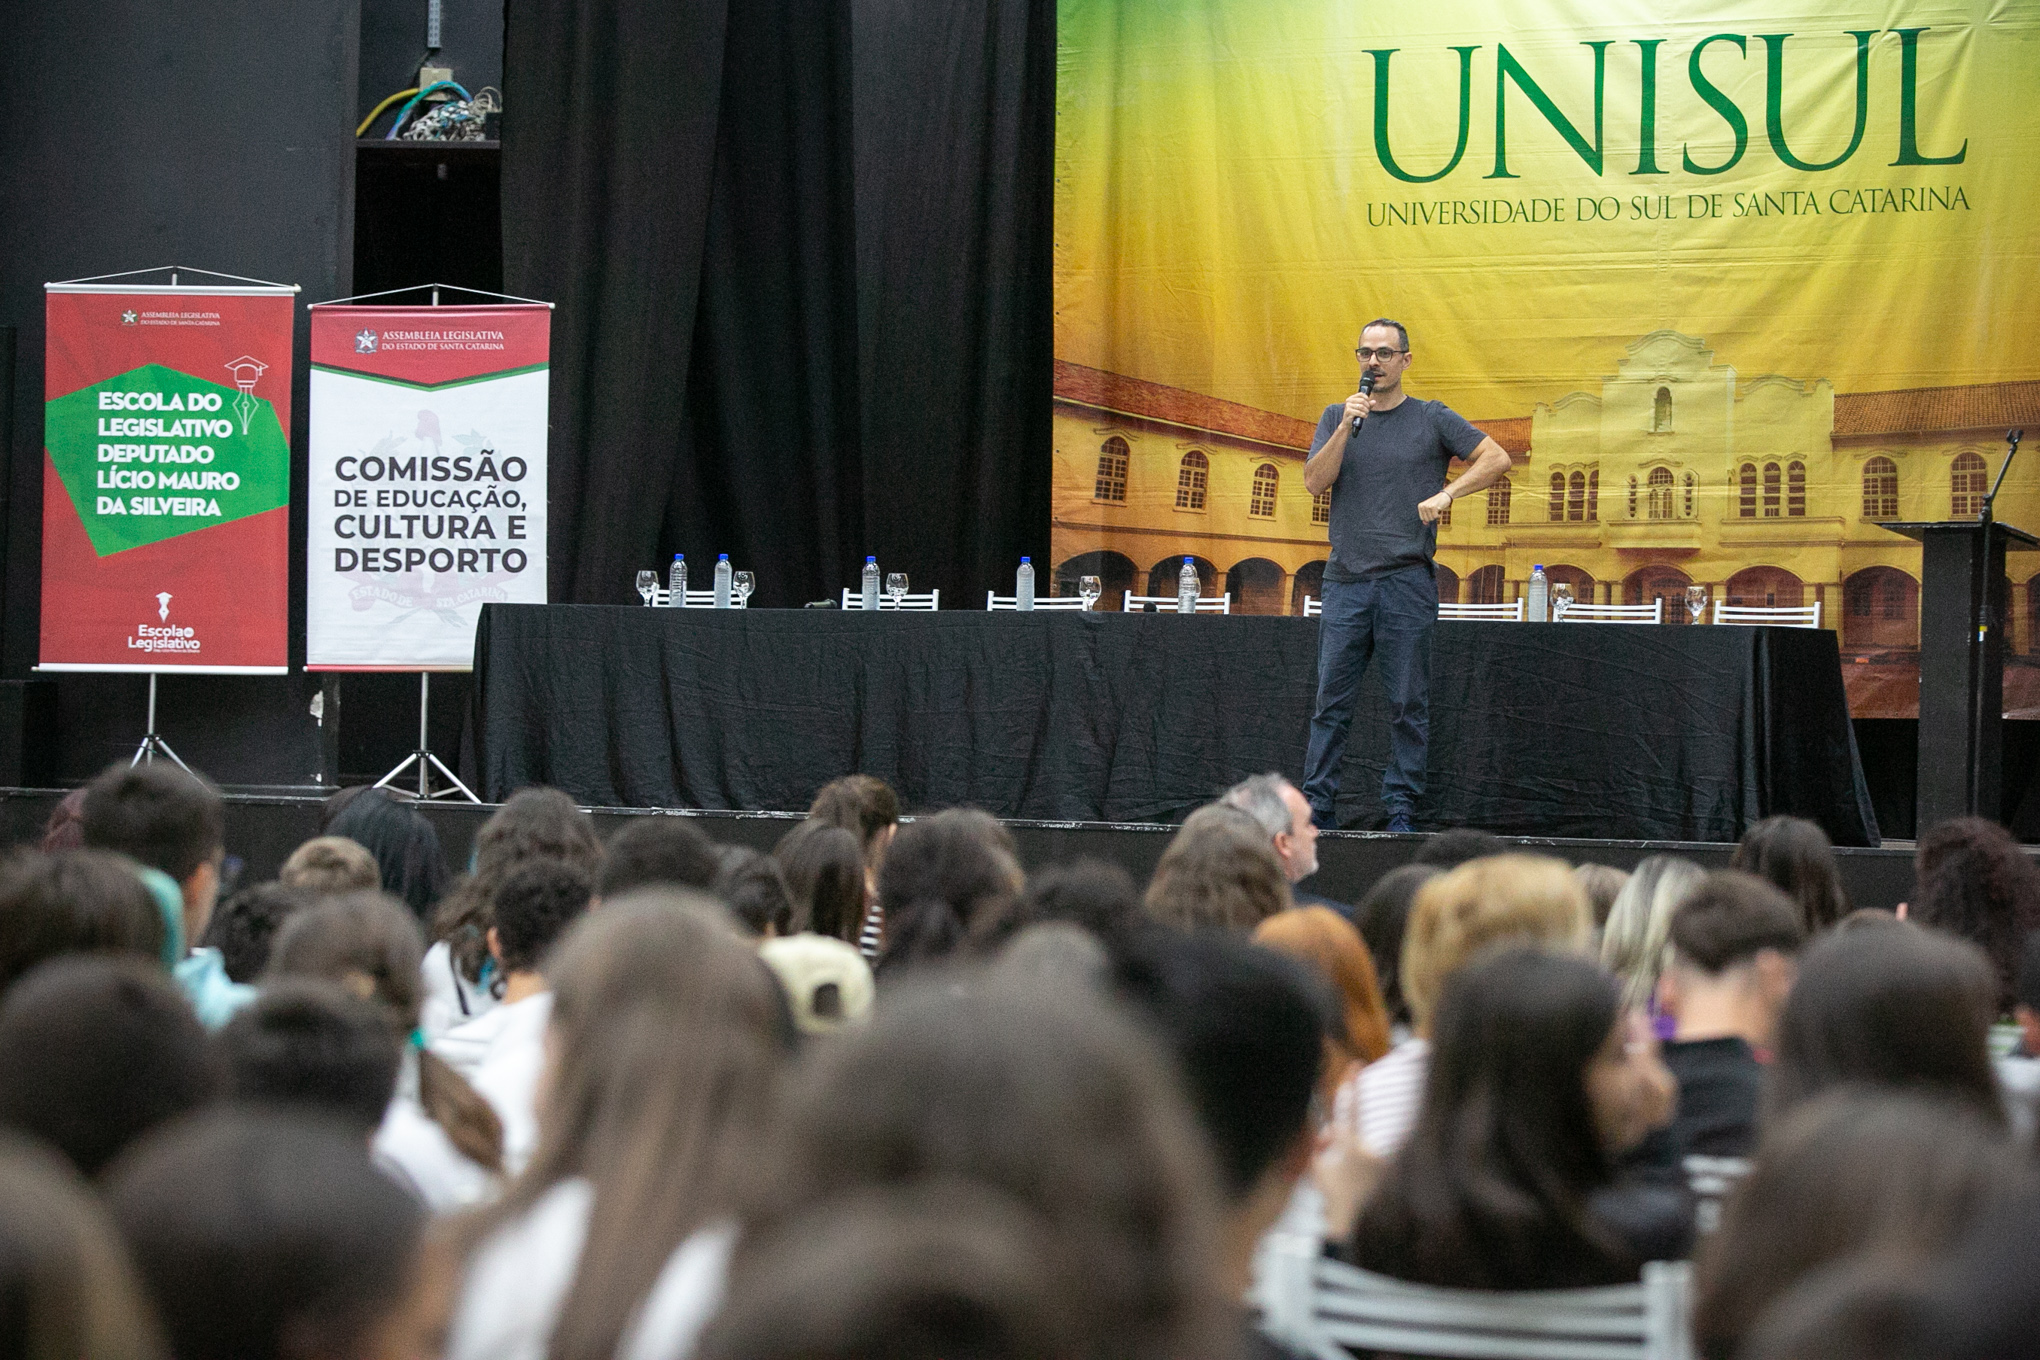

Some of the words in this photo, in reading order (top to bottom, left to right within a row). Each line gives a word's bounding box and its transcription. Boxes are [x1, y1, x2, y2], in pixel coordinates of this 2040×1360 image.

[1361, 27, 1968, 184] UNISUL
[1367, 198, 1565, 227] UNIVERSIDADE
[1576, 196, 1621, 222] DO
[1630, 195, 1678, 220] SUL
[1687, 193, 1723, 219] DE
[1733, 191, 1821, 218] SANTA
[1829, 186, 1972, 214] CATARINA
[382, 331, 441, 340] ASSEMBLEIA
[443, 331, 504, 340] LEGISLATIVA
[98, 391, 185, 411] ESCOLA
[187, 392, 222, 412] DO
[97, 417, 233, 438] LEGISLATIVO
[97, 444, 215, 464] DEPUTADO
[335, 449, 528, 482] COMISSÃO
[97, 465, 156, 489] LÍCIO
[158, 471, 240, 491] MAURO
[96, 496, 128, 515] DA
[129, 496, 222, 516] SILVEIRA
[334, 489, 368, 508] DE
[376, 484, 527, 513] EDUCAÇÃO,
[334, 514, 497, 540] CULTURA
[507, 515, 527, 540] E
[335, 547, 528, 573] DESPORTO
[353, 585, 397, 601] ESTADO
[138, 624, 184, 637] Escola
[127, 635, 201, 653] Legislativo
